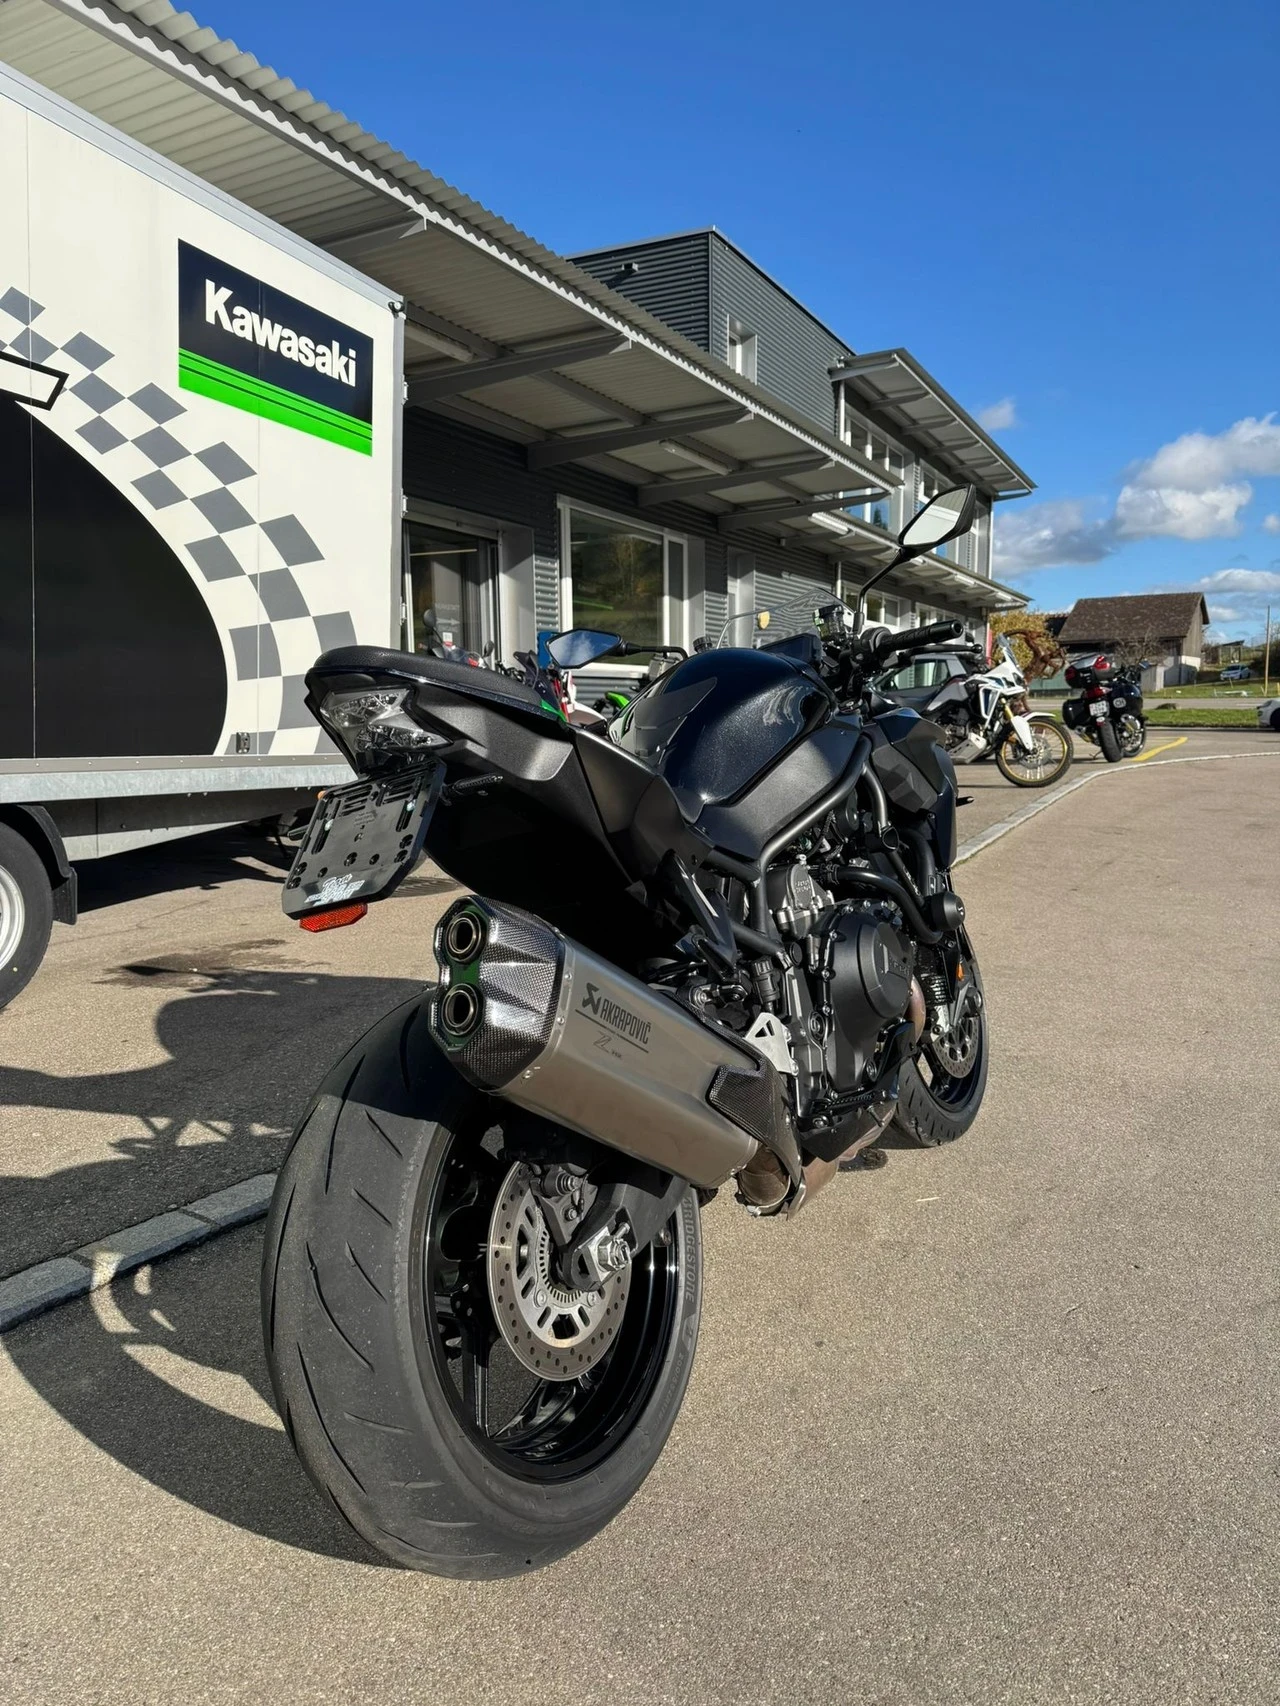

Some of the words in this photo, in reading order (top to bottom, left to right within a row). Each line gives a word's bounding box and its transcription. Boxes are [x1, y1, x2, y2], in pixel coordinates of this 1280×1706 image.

[205, 278, 356, 387] Kawasaki
[600, 998, 651, 1045] AKRAPOVIČ
[682, 1197, 696, 1303] BRIDGESTONE
